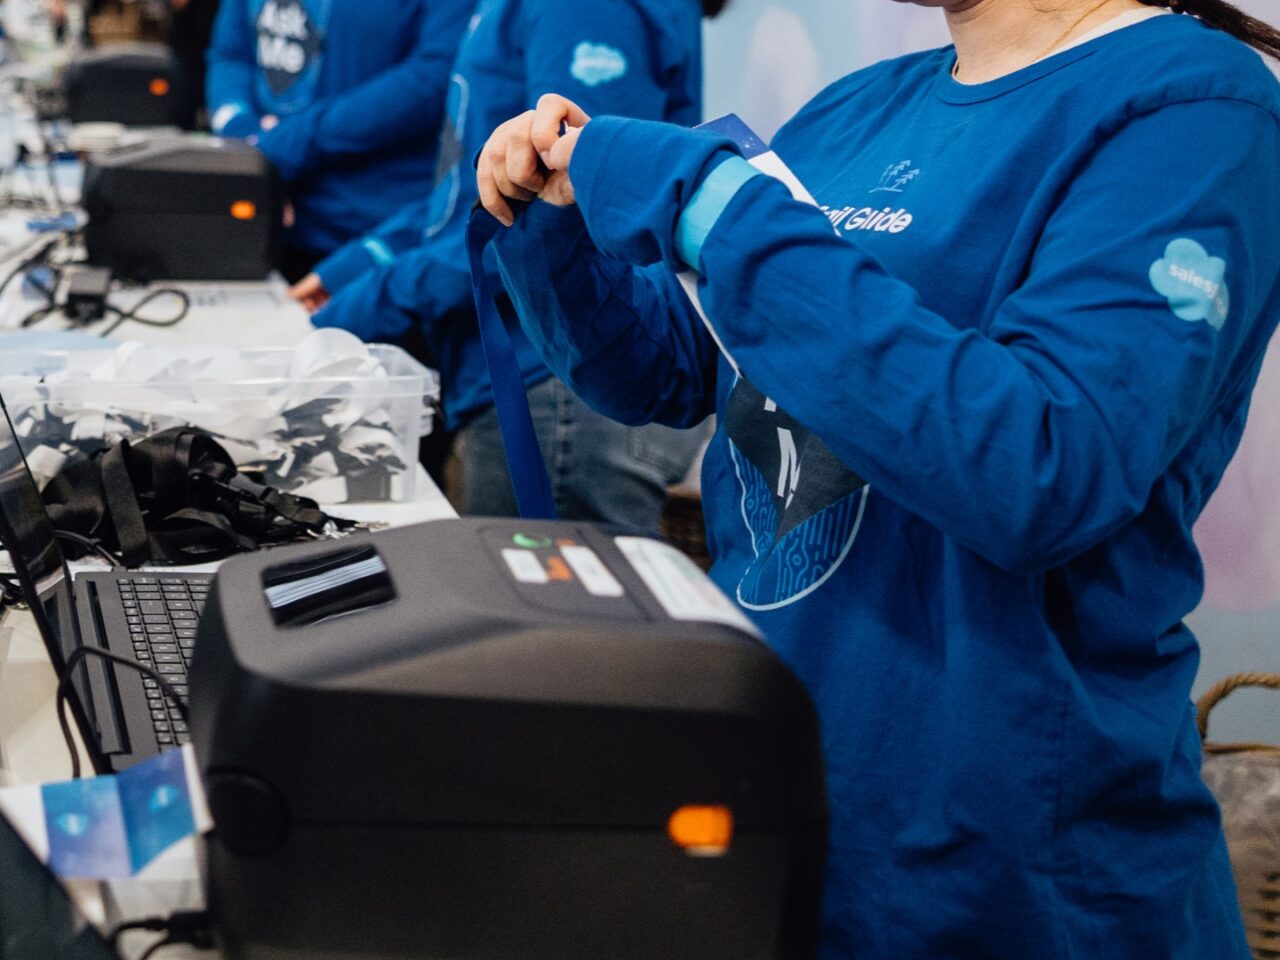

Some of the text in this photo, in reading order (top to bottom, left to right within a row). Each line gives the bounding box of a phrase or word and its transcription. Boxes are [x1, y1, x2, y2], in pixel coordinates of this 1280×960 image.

[257, 34, 305, 73] Me
[820, 205, 854, 228] ail
[1168, 263, 1225, 316] salesf
